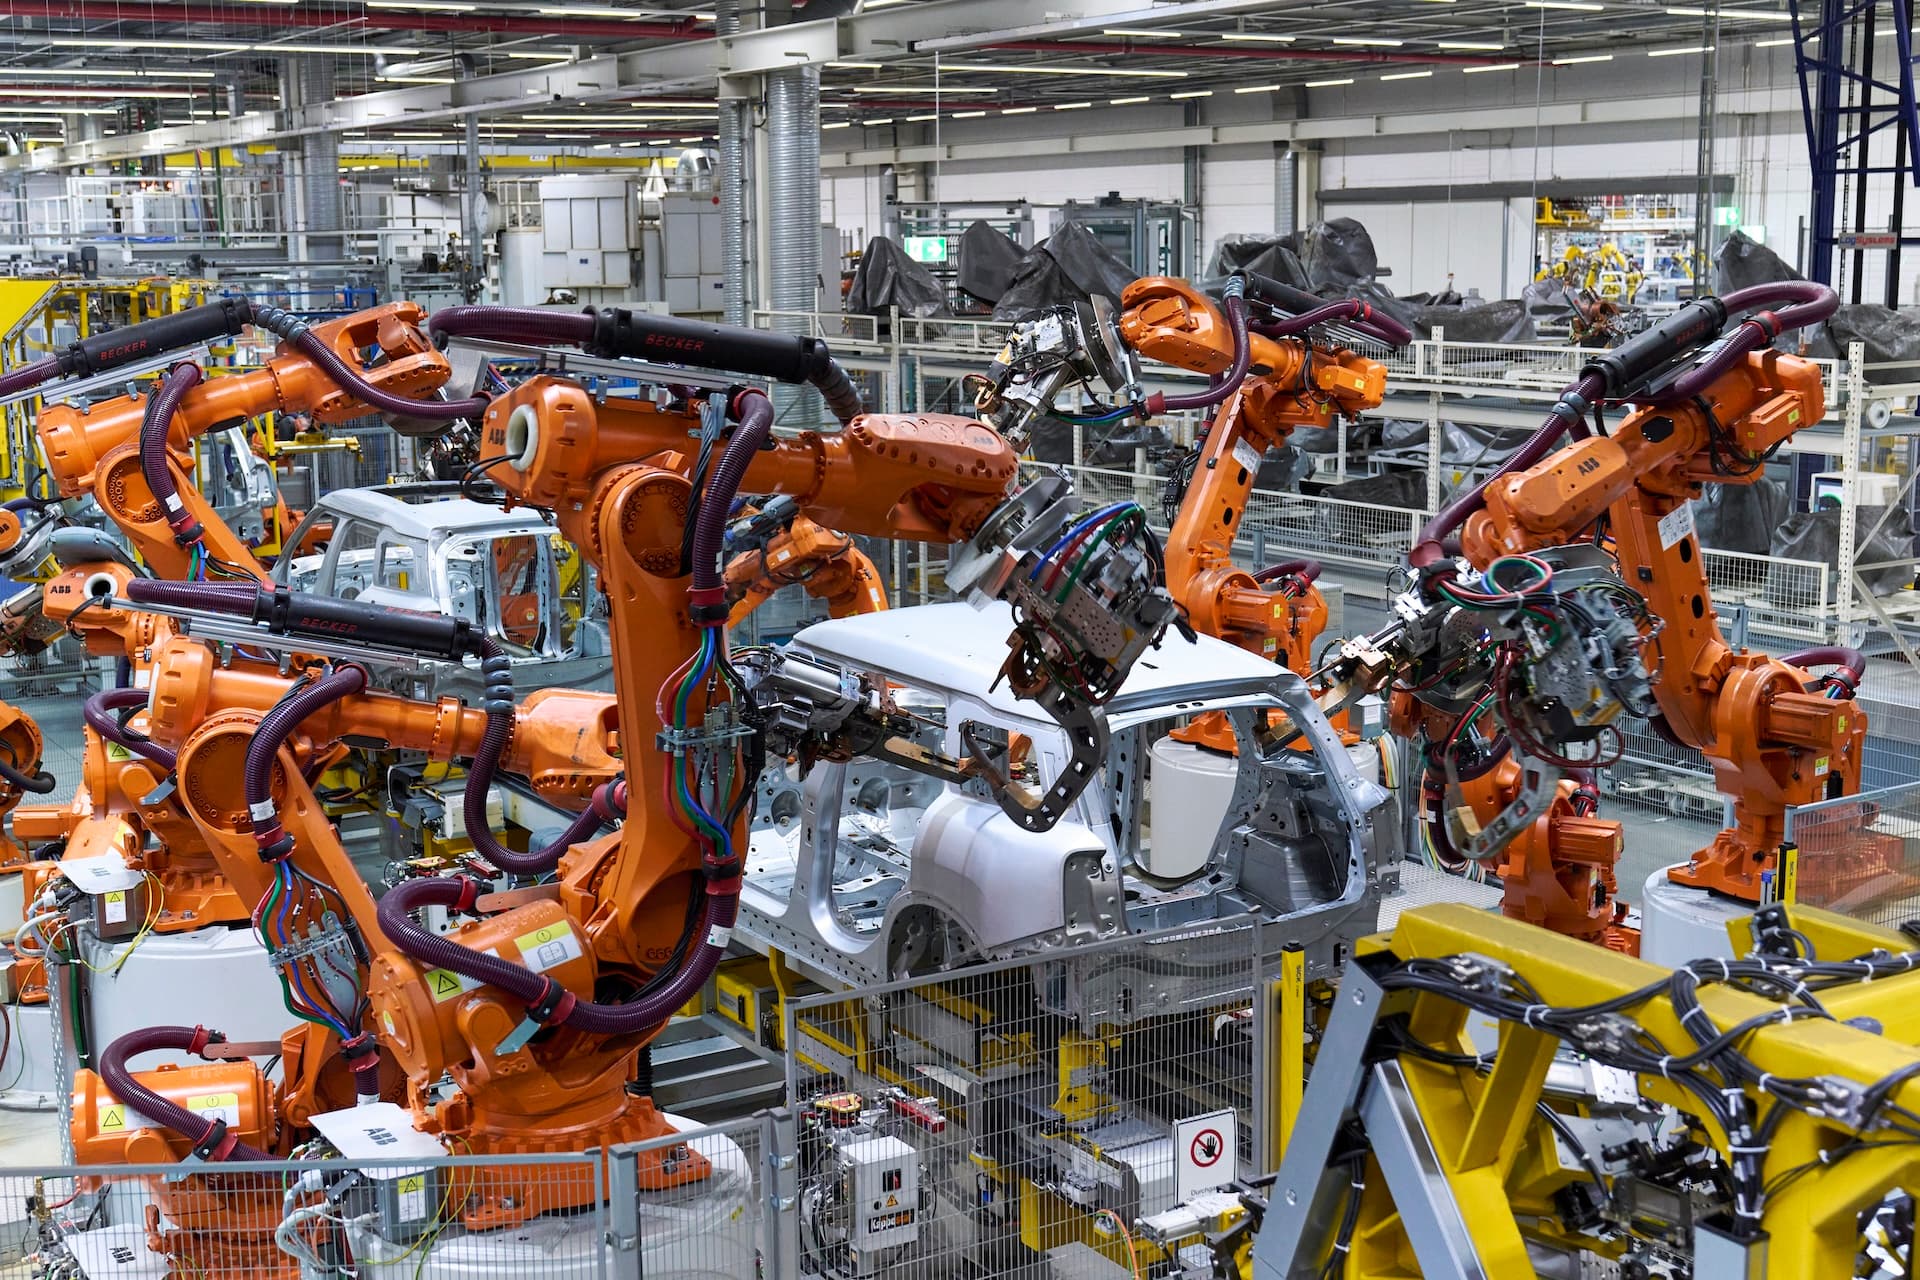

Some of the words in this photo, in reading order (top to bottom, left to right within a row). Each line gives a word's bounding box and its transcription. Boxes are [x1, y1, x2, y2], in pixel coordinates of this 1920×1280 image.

[99, 339, 148, 360] BECKER
[645, 333, 705, 352] BECKER
[488, 427, 506, 446] ABB
[1577, 457, 1600, 476] ABB
[50, 585, 72, 594] ABB
[299, 616, 358, 635] BECKER
[362, 1127, 398, 1146] ABB
[109, 1246, 136, 1264] ABB
